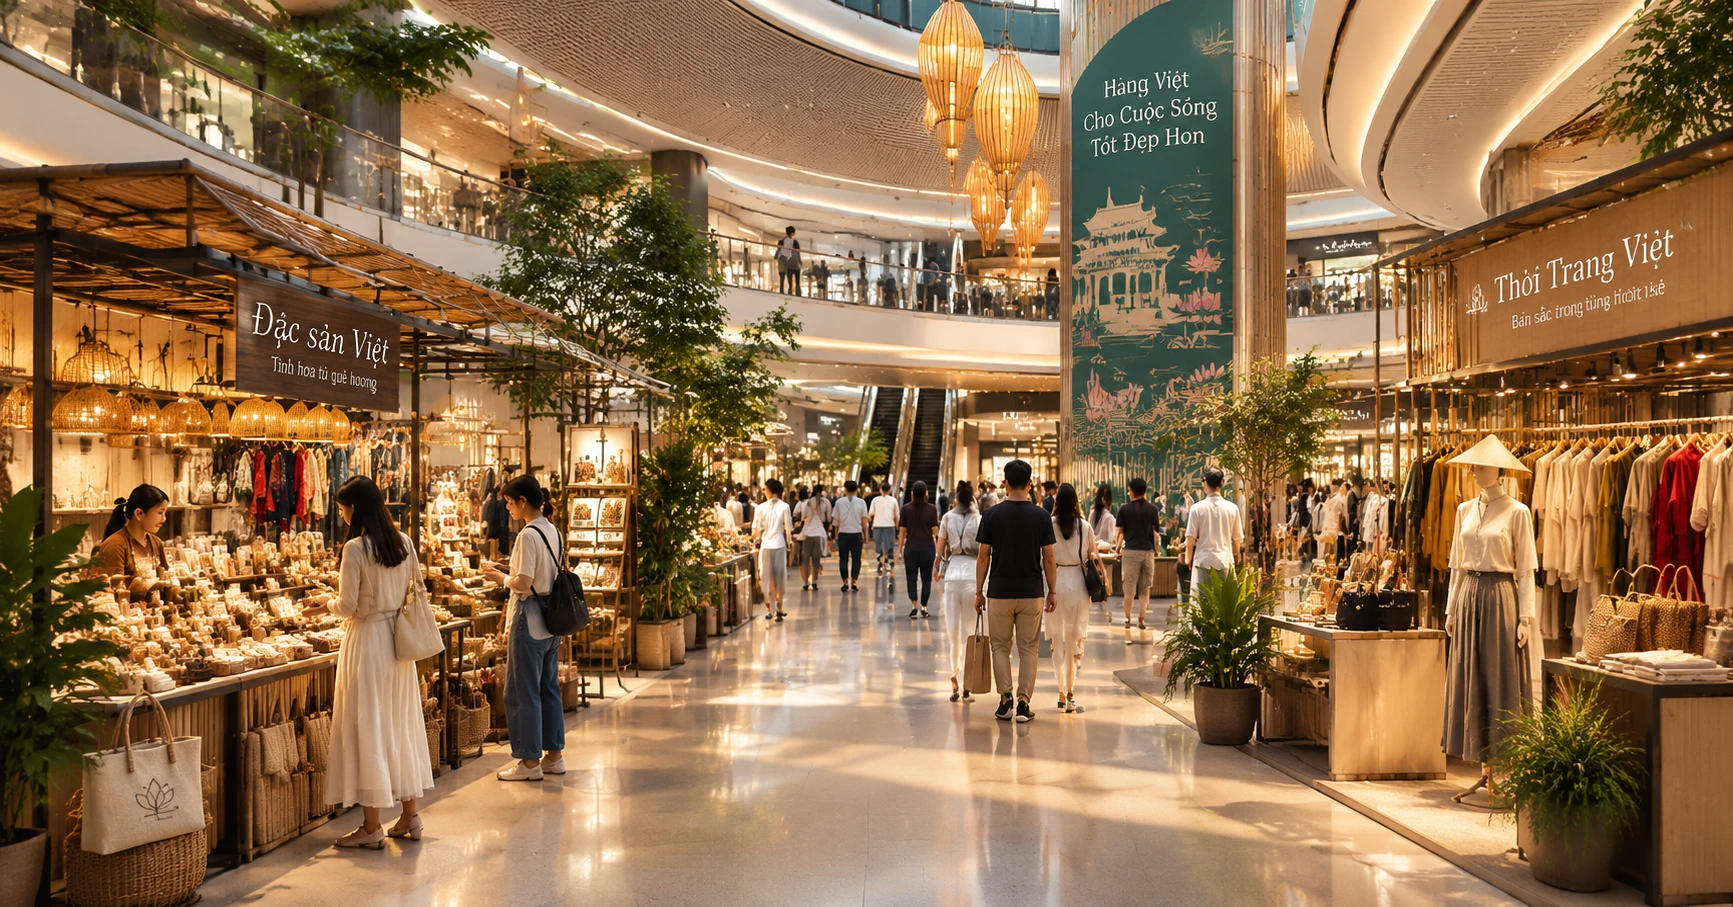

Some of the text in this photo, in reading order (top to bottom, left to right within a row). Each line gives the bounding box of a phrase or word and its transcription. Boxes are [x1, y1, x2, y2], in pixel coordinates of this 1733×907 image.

[1083, 111, 1115, 132] Cho
[1123, 132, 1159, 154] Đẹp
[1164, 127, 1205, 147] Hon
[1546, 251, 1615, 290] Trang
[1622, 229, 1675, 270] Việt
[307, 323, 345, 355] sản
[352, 328, 390, 369] Việt
[297, 360, 315, 378] hoa
